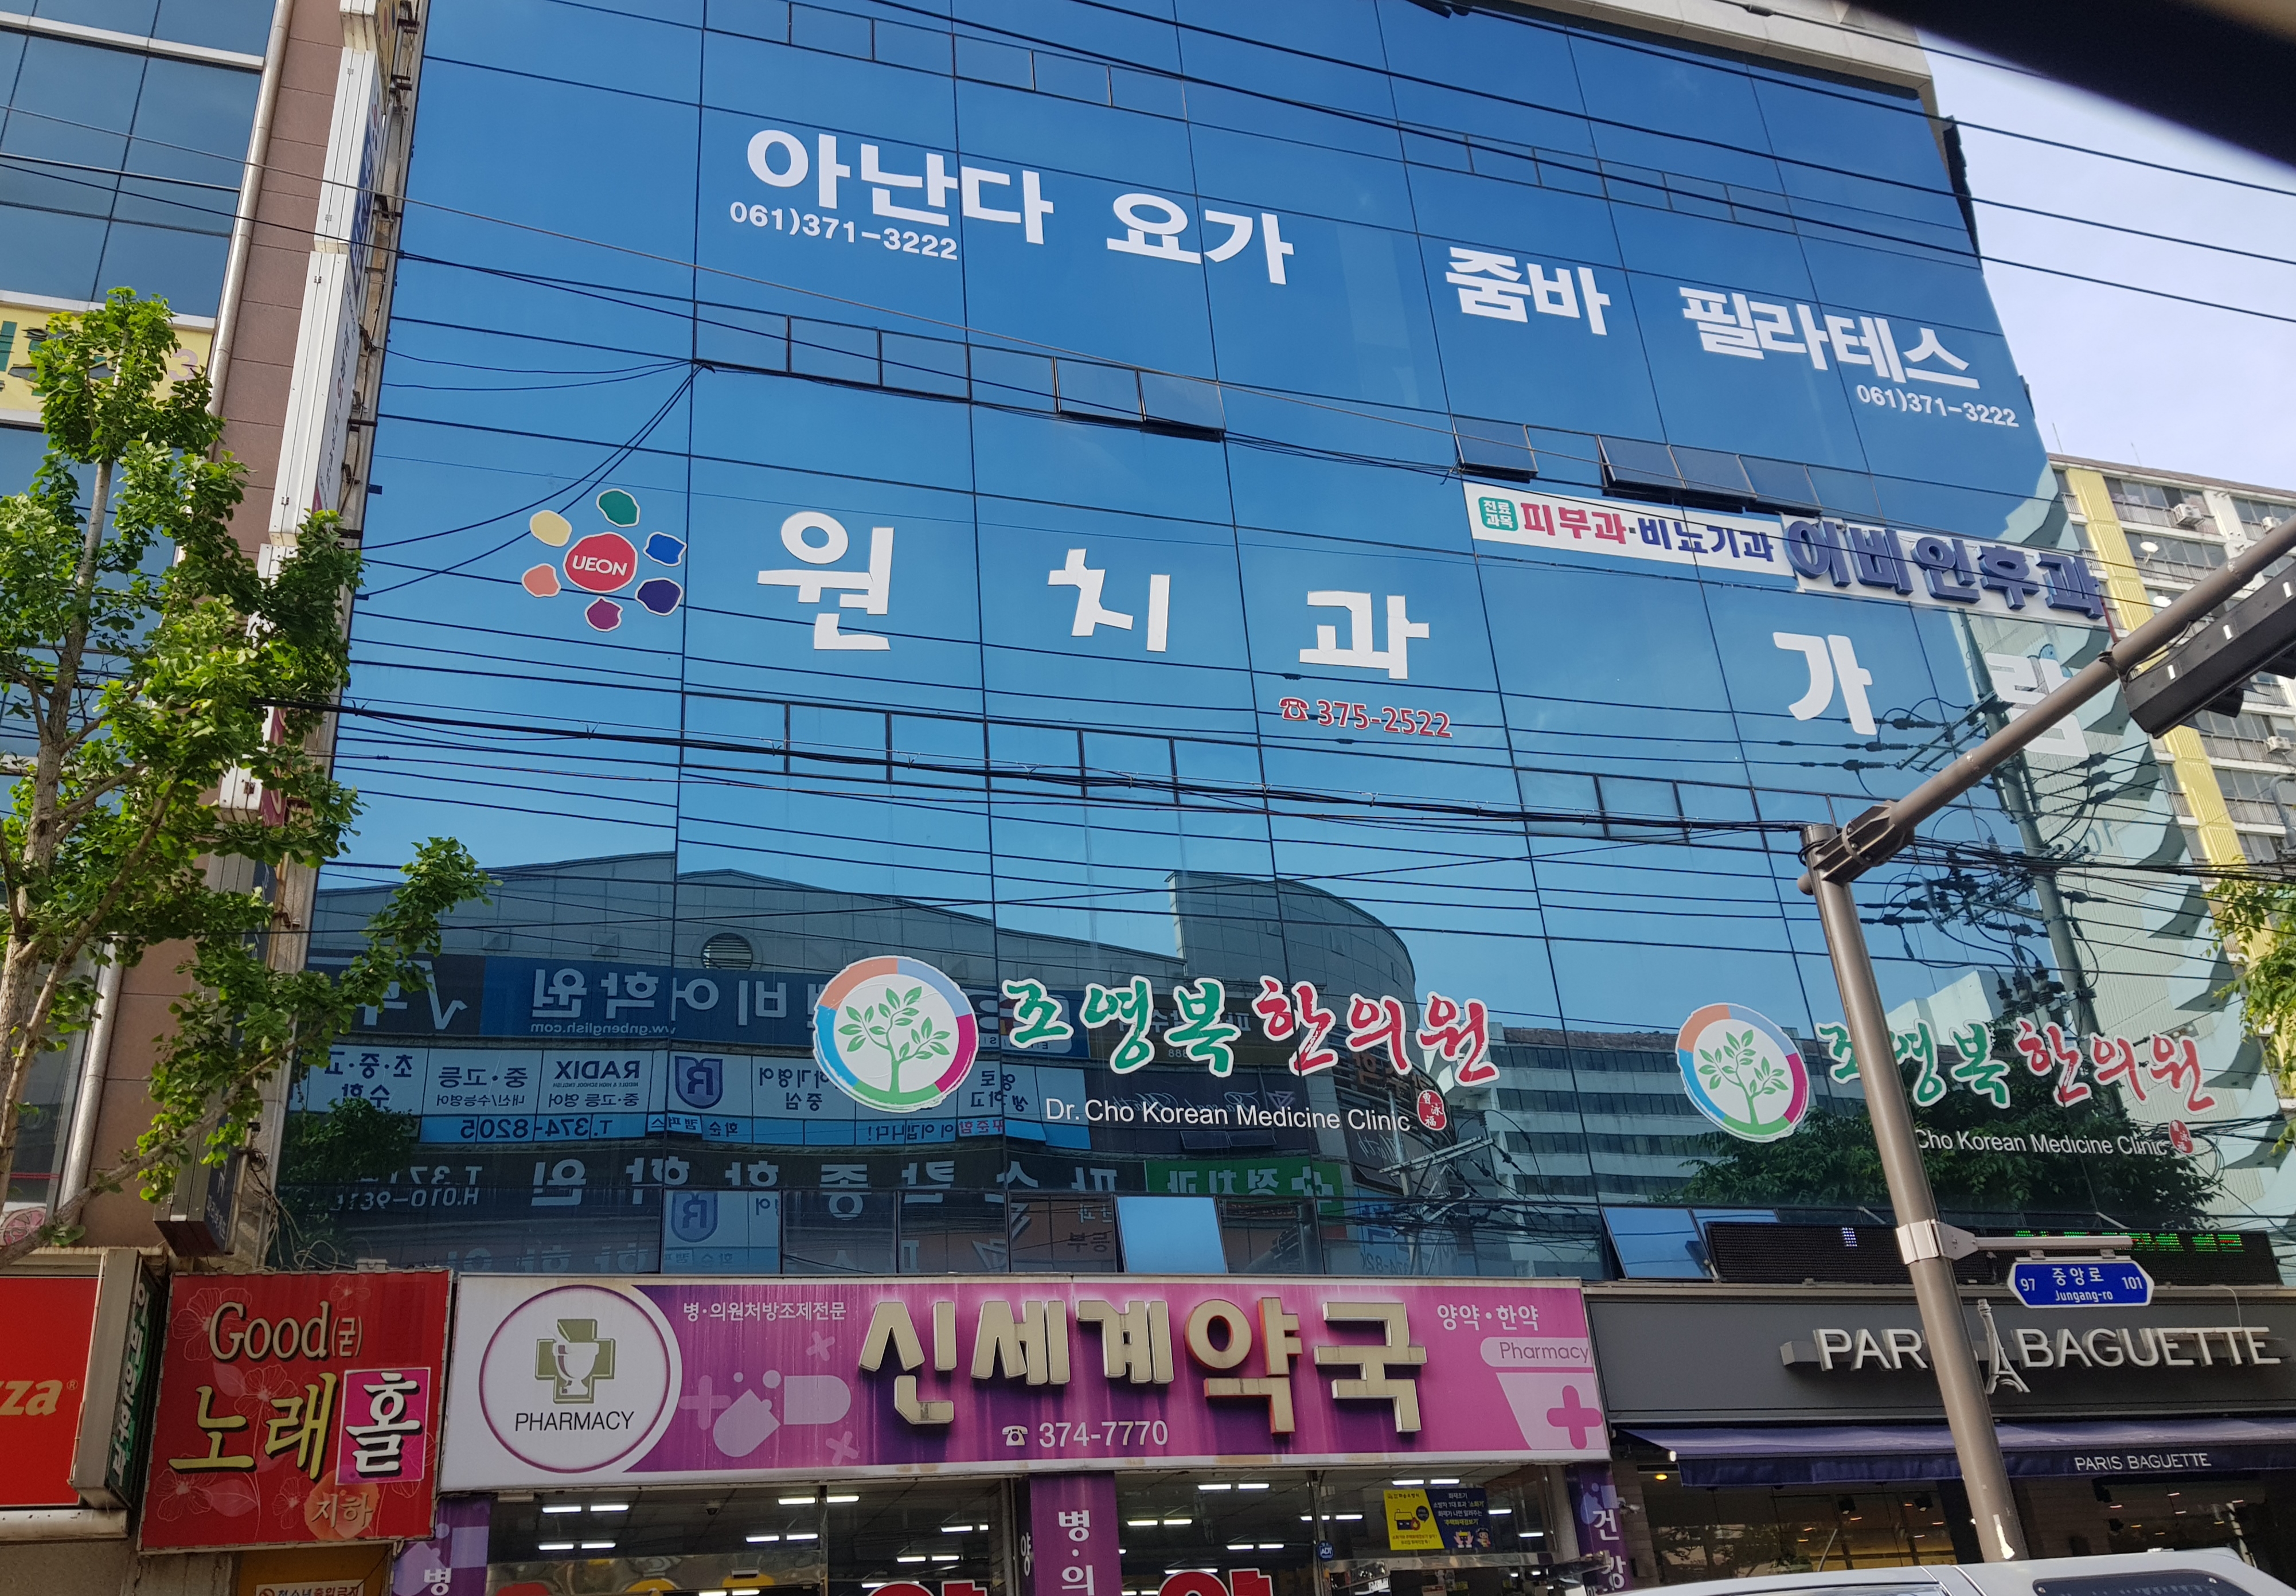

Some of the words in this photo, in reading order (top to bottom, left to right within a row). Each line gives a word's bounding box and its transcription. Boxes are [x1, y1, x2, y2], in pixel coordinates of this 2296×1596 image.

[729, 201, 958, 261] 061)371-3222
[747, 130, 1054, 245] 아난다
[1107, 193, 1294, 286] 요가
[1446, 247, 1611, 336] 줌바
[1679, 286, 1980, 389] 필라테스
[1857, 385, 2019, 428] 061)371-3222
[1482, 500, 1512, 516] 진료
[1486, 513, 1514, 529] 과목
[572, 555, 628, 576] UEON
[1783, 517, 2106, 620] 이비인후과
[1317, 699, 1452, 739] 375-2522
[1001, 974, 1501, 1087] 조영복한의원
[1046, 1098, 1080, 1122] Dr.
[1084, 1098, 1136, 1123] Cho
[1143, 1101, 1229, 1126] Korean
[1235, 1105, 1341, 1130] Medicine
[1347, 1107, 1411, 1133] Clinic
[1915, 1128, 1954, 1152] Cho
[1957, 1130, 2026, 1154] Korean
[2032, 1131, 2113, 1155] Medicine
[2117, 1133, 2168, 1157] Clinic
[2020, 1278, 2036, 1292] 97
[2052, 1267, 2103, 1286] 중앙로
[2122, 1276, 2143, 1290] 101
[2055, 1290, 2113, 1303] Jungang-ro
[1500, 1341, 1590, 1365] Pharmacy
[1813, 1326, 1944, 1372] PAR
[2012, 1325, 2282, 1369] BAGUETTE
[858, 1297, 1427, 1435] 신세계약국
[514, 1411, 634, 1432] PHARMACY
[1038, 1420, 1168, 1447] 374-7770
[2075, 1456, 2123, 1472] PARIS
[2127, 1452, 2212, 1469] BAGUETTE
[311, 1493, 374, 1528] 지하
